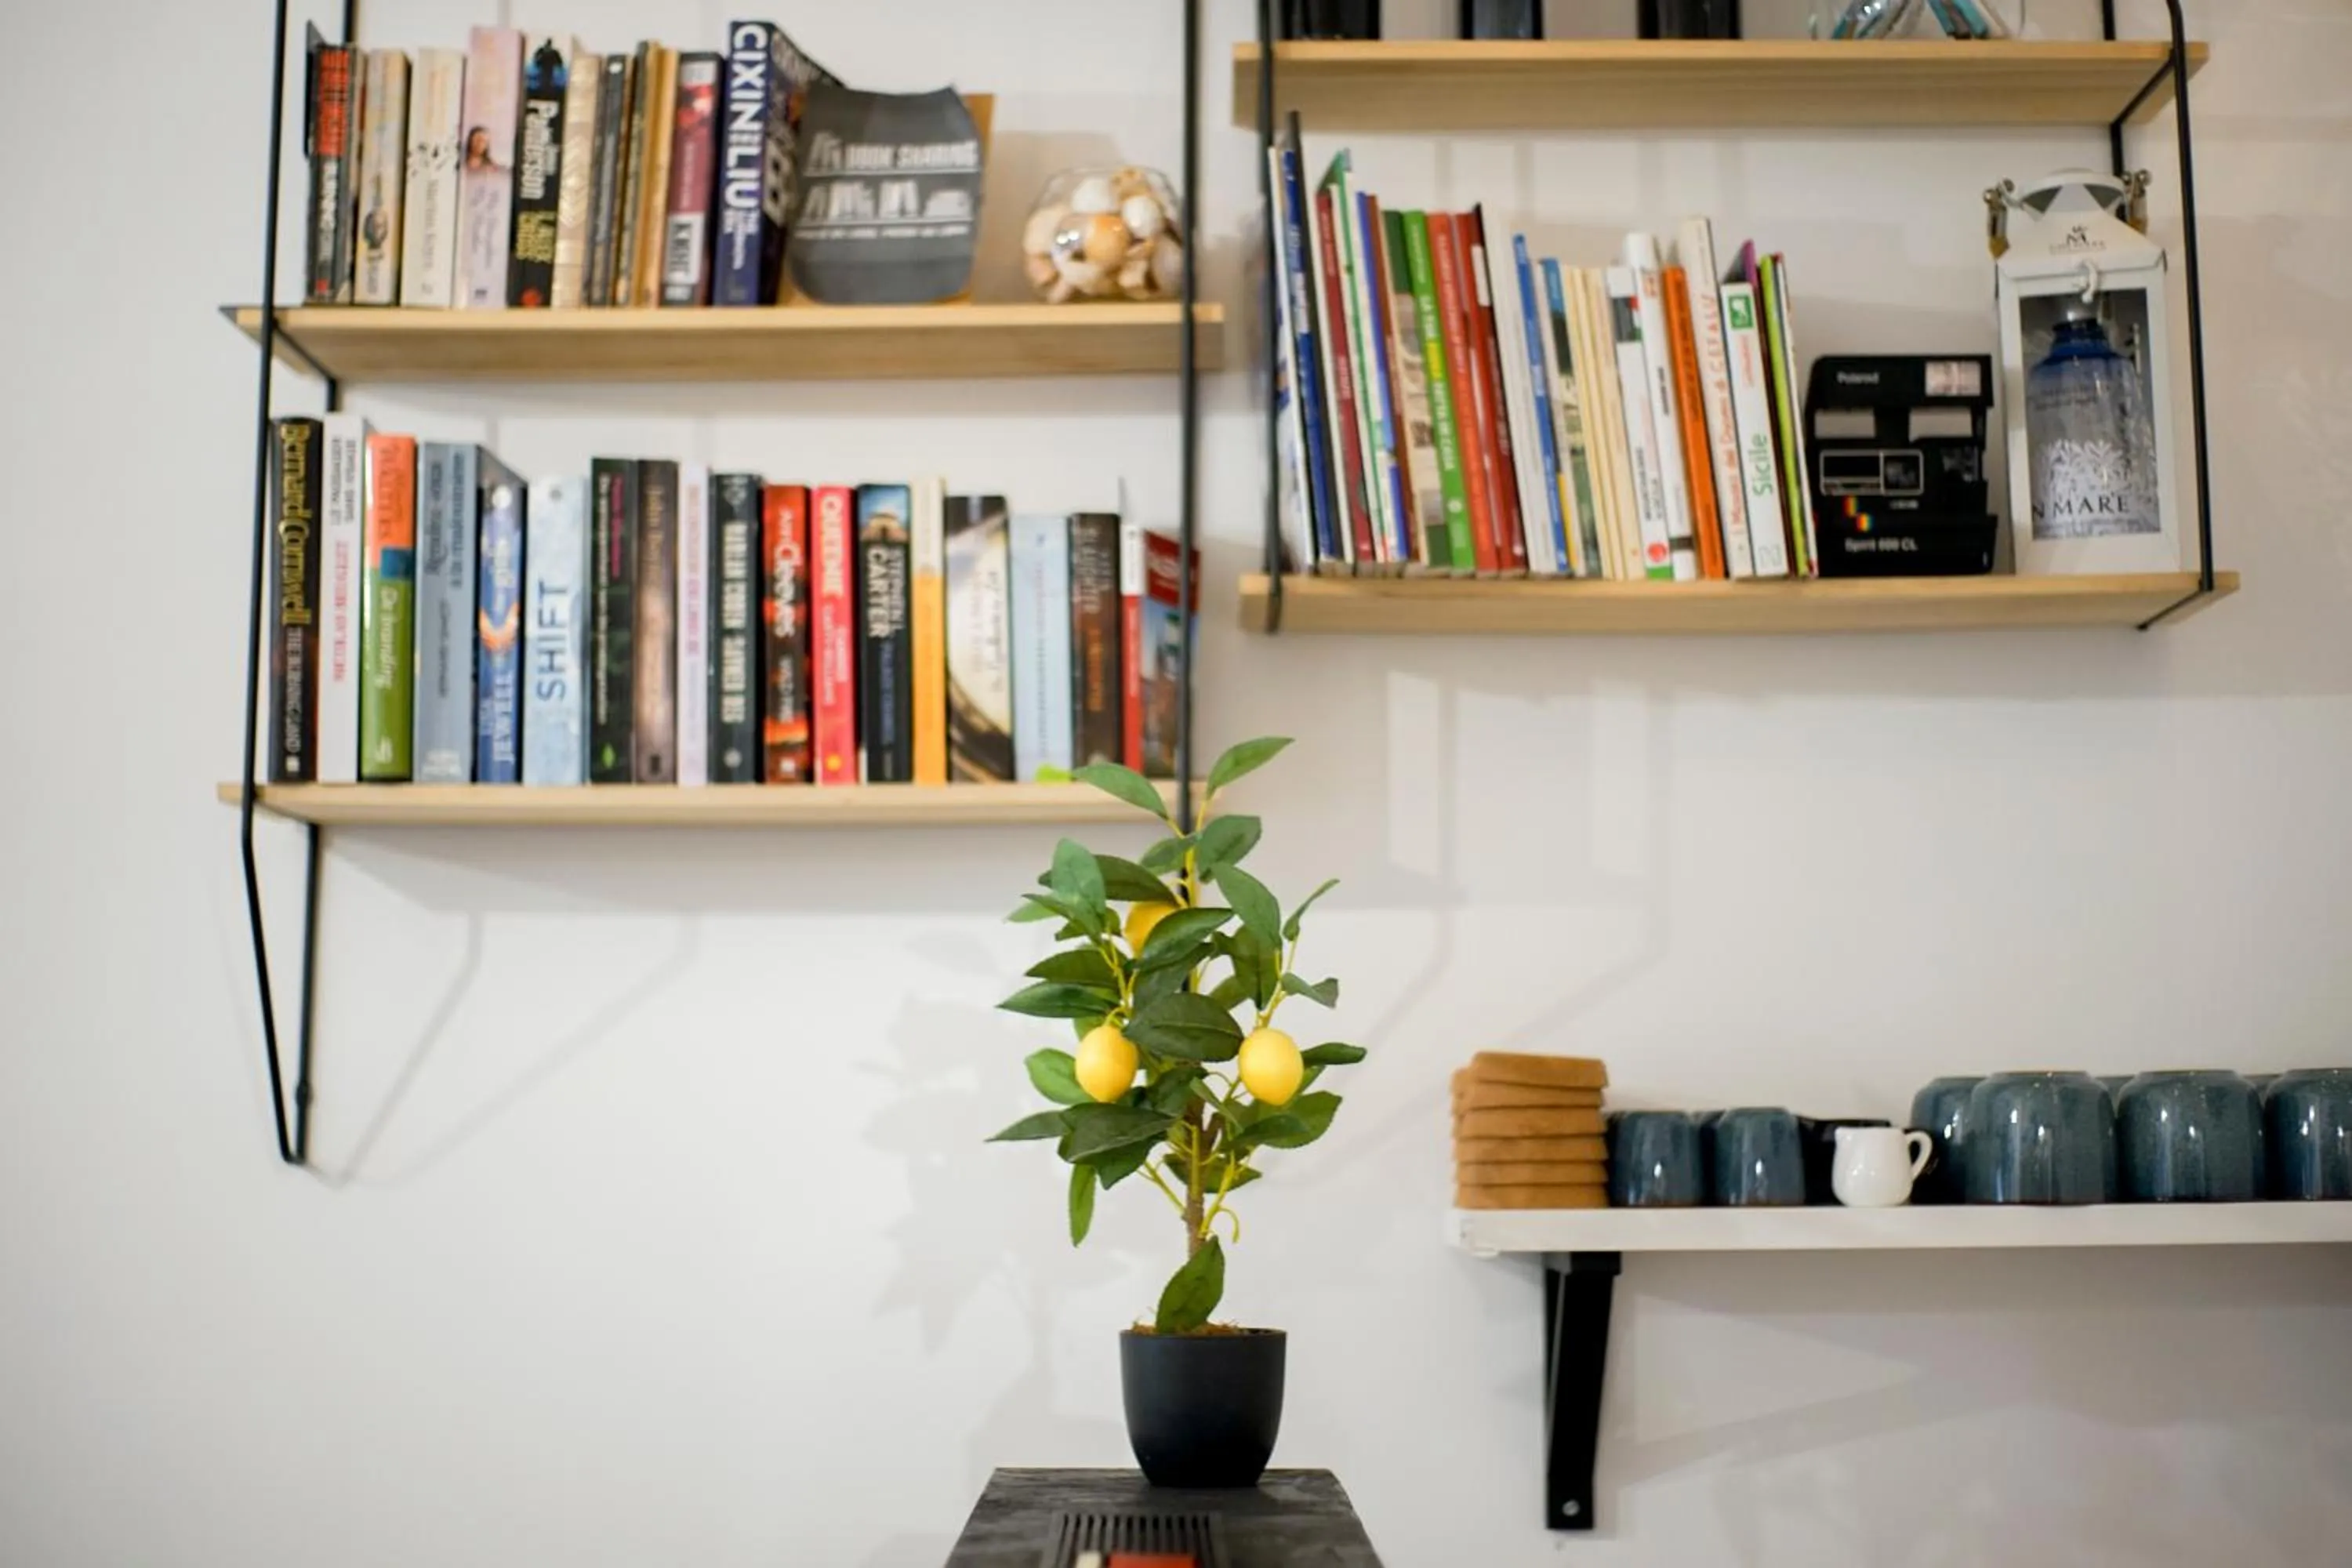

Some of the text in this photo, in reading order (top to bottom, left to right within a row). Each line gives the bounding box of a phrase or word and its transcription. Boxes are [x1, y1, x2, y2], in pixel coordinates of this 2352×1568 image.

[728, 24, 768, 131] CIXIN
[725, 146, 763, 209] LIU
[1748, 433, 1775, 497] Sicile
[279, 423, 312, 626] Bernard Cornwell
[867, 546, 891, 638] CARTER
[373, 615, 398, 690] branding
[535, 579, 568, 702] SHIFT
